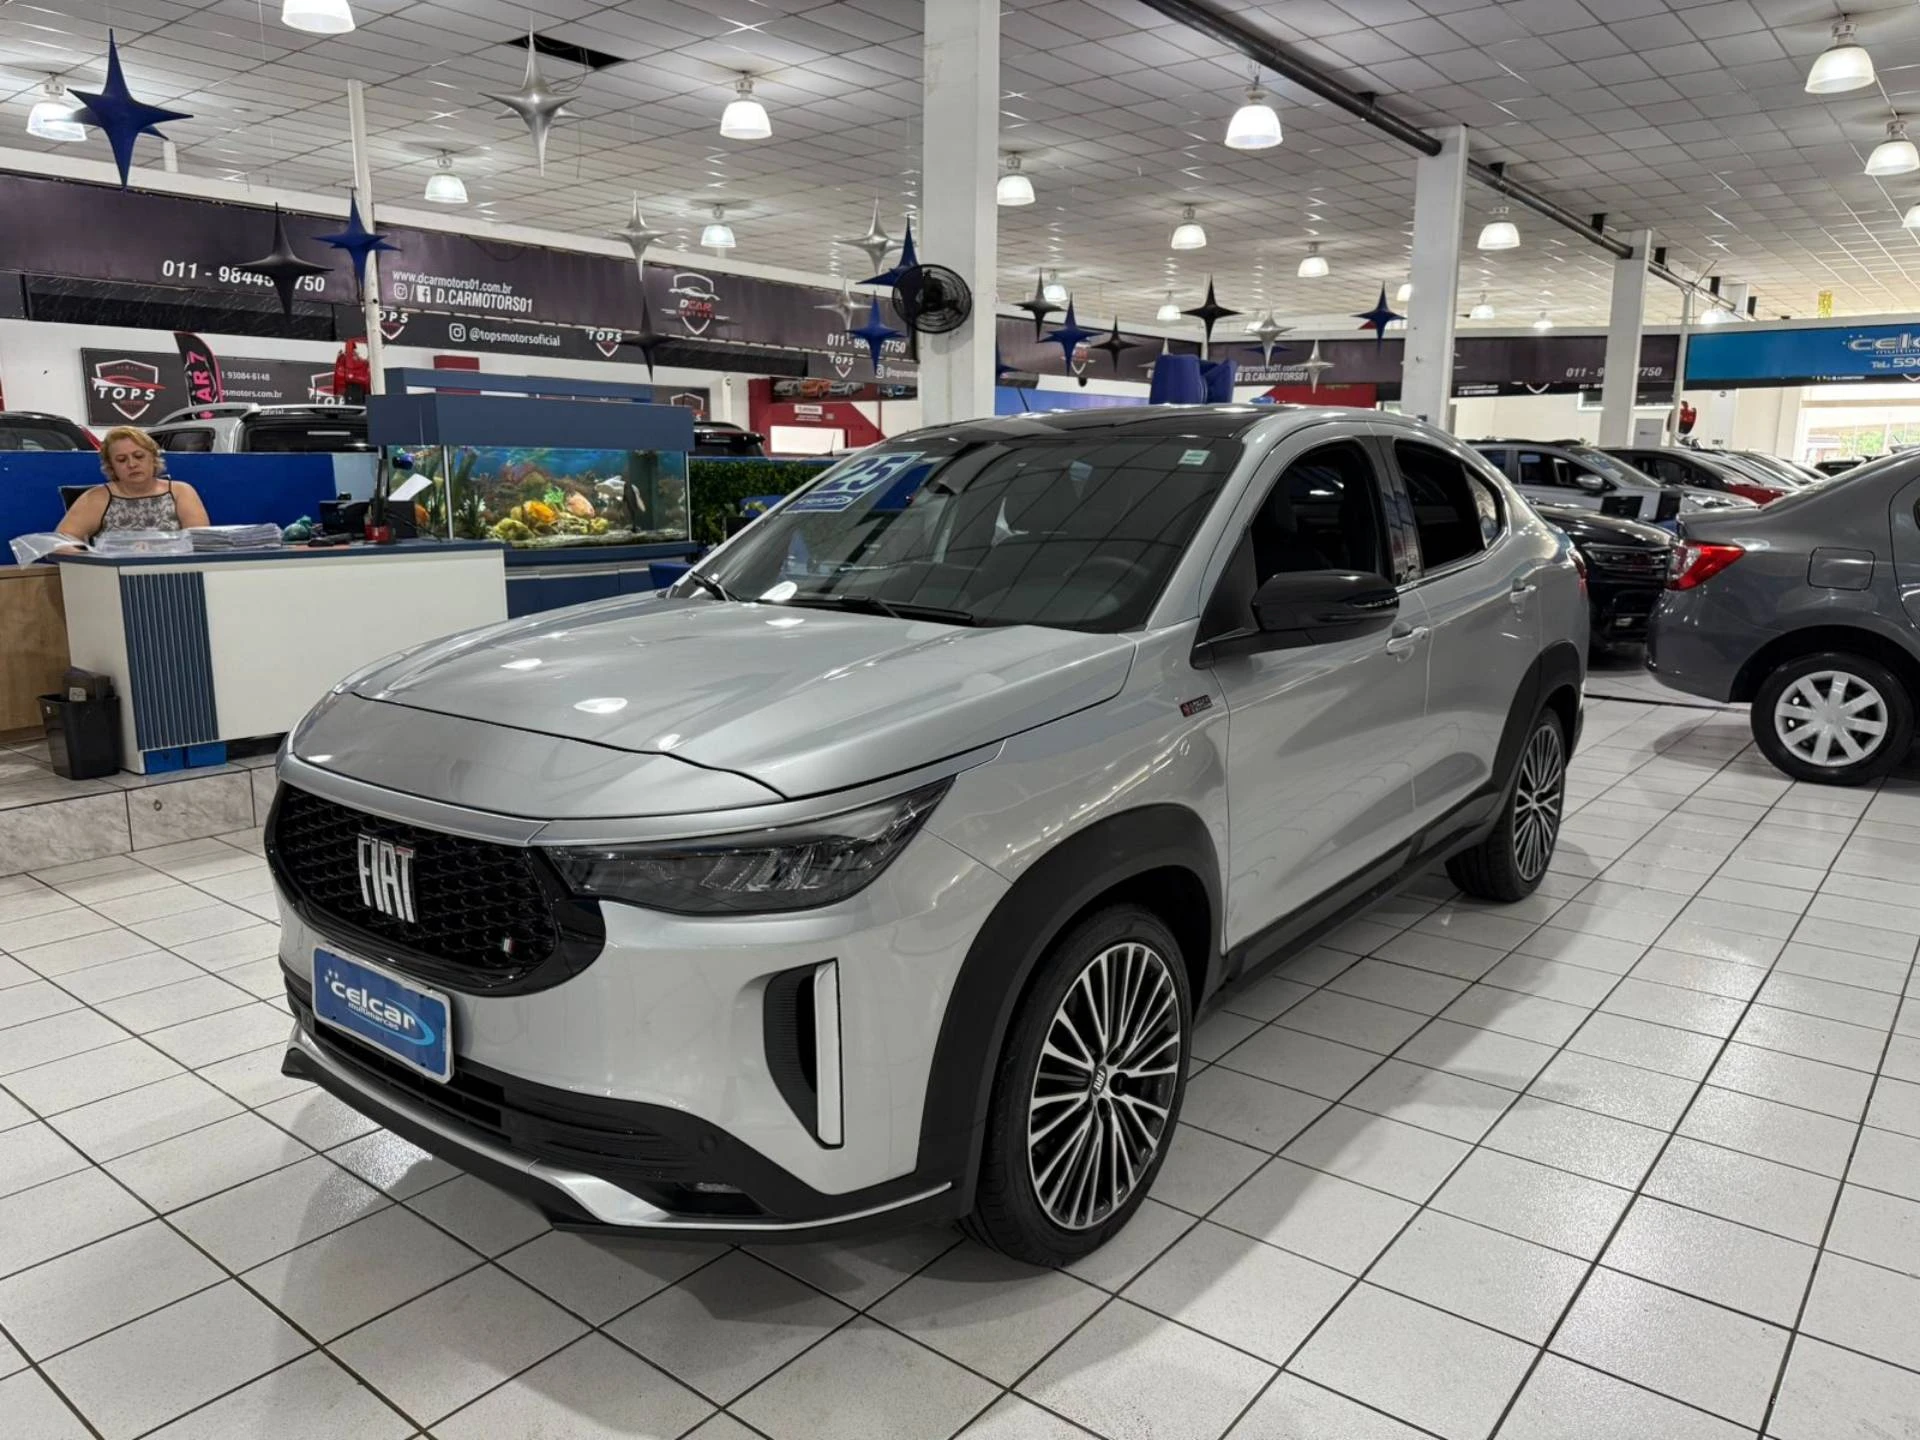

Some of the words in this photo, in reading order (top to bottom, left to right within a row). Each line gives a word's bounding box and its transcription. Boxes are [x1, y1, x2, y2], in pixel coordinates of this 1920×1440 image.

[162, 260, 198, 279] 011
[392, 270, 513, 294] www.dcarmotors01.com.br
[435, 289, 534, 313] D.CARMOTORS01
[379, 310, 409, 323] OPS
[469, 327, 561, 346] @topsmotorsoficial
[588, 331, 622, 342] TOPS
[827, 334, 845, 347] 011
[1847, 332, 1920, 351] cel
[828, 354, 855, 366] TOPS
[98, 387, 156, 401] TOPS
[358, 833, 415, 923] FIAT
[331, 980, 416, 1031] celcar
